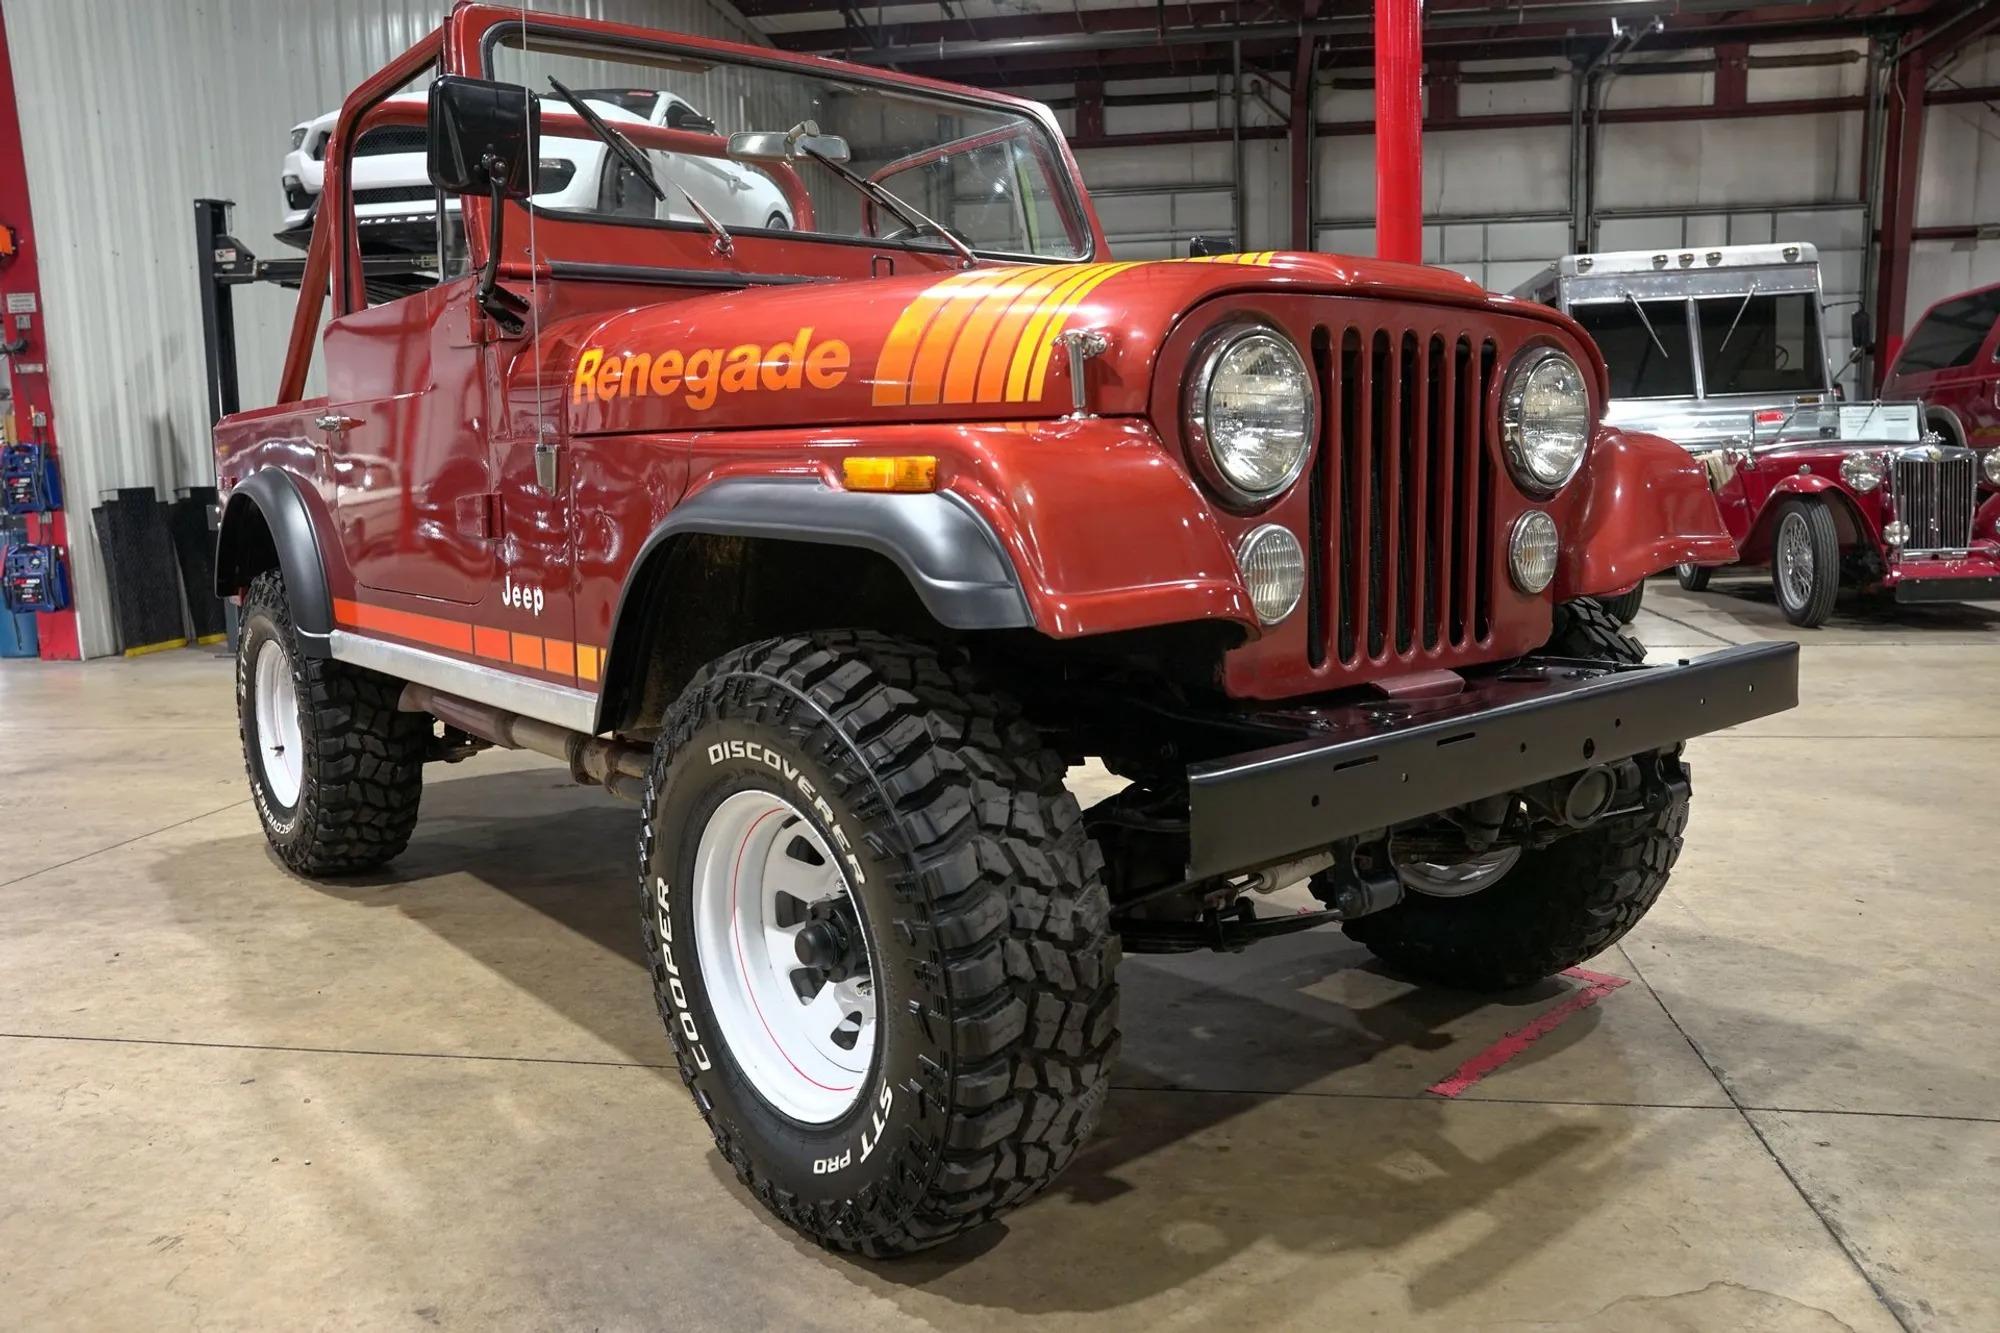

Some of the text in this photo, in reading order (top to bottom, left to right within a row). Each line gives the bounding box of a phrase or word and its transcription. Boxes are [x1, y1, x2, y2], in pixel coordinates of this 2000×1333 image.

[360, 215, 436, 225] HELBY
[573, 326, 850, 411] Renegade
[502, 575, 544, 616] Jeep
[240, 652, 248, 700] STT
[255, 781, 295, 834] DISCOVERER
[707, 740, 865, 884] DISCOVERER
[657, 876, 712, 1071] COOPER
[813, 1077, 893, 1174] STT PRO
